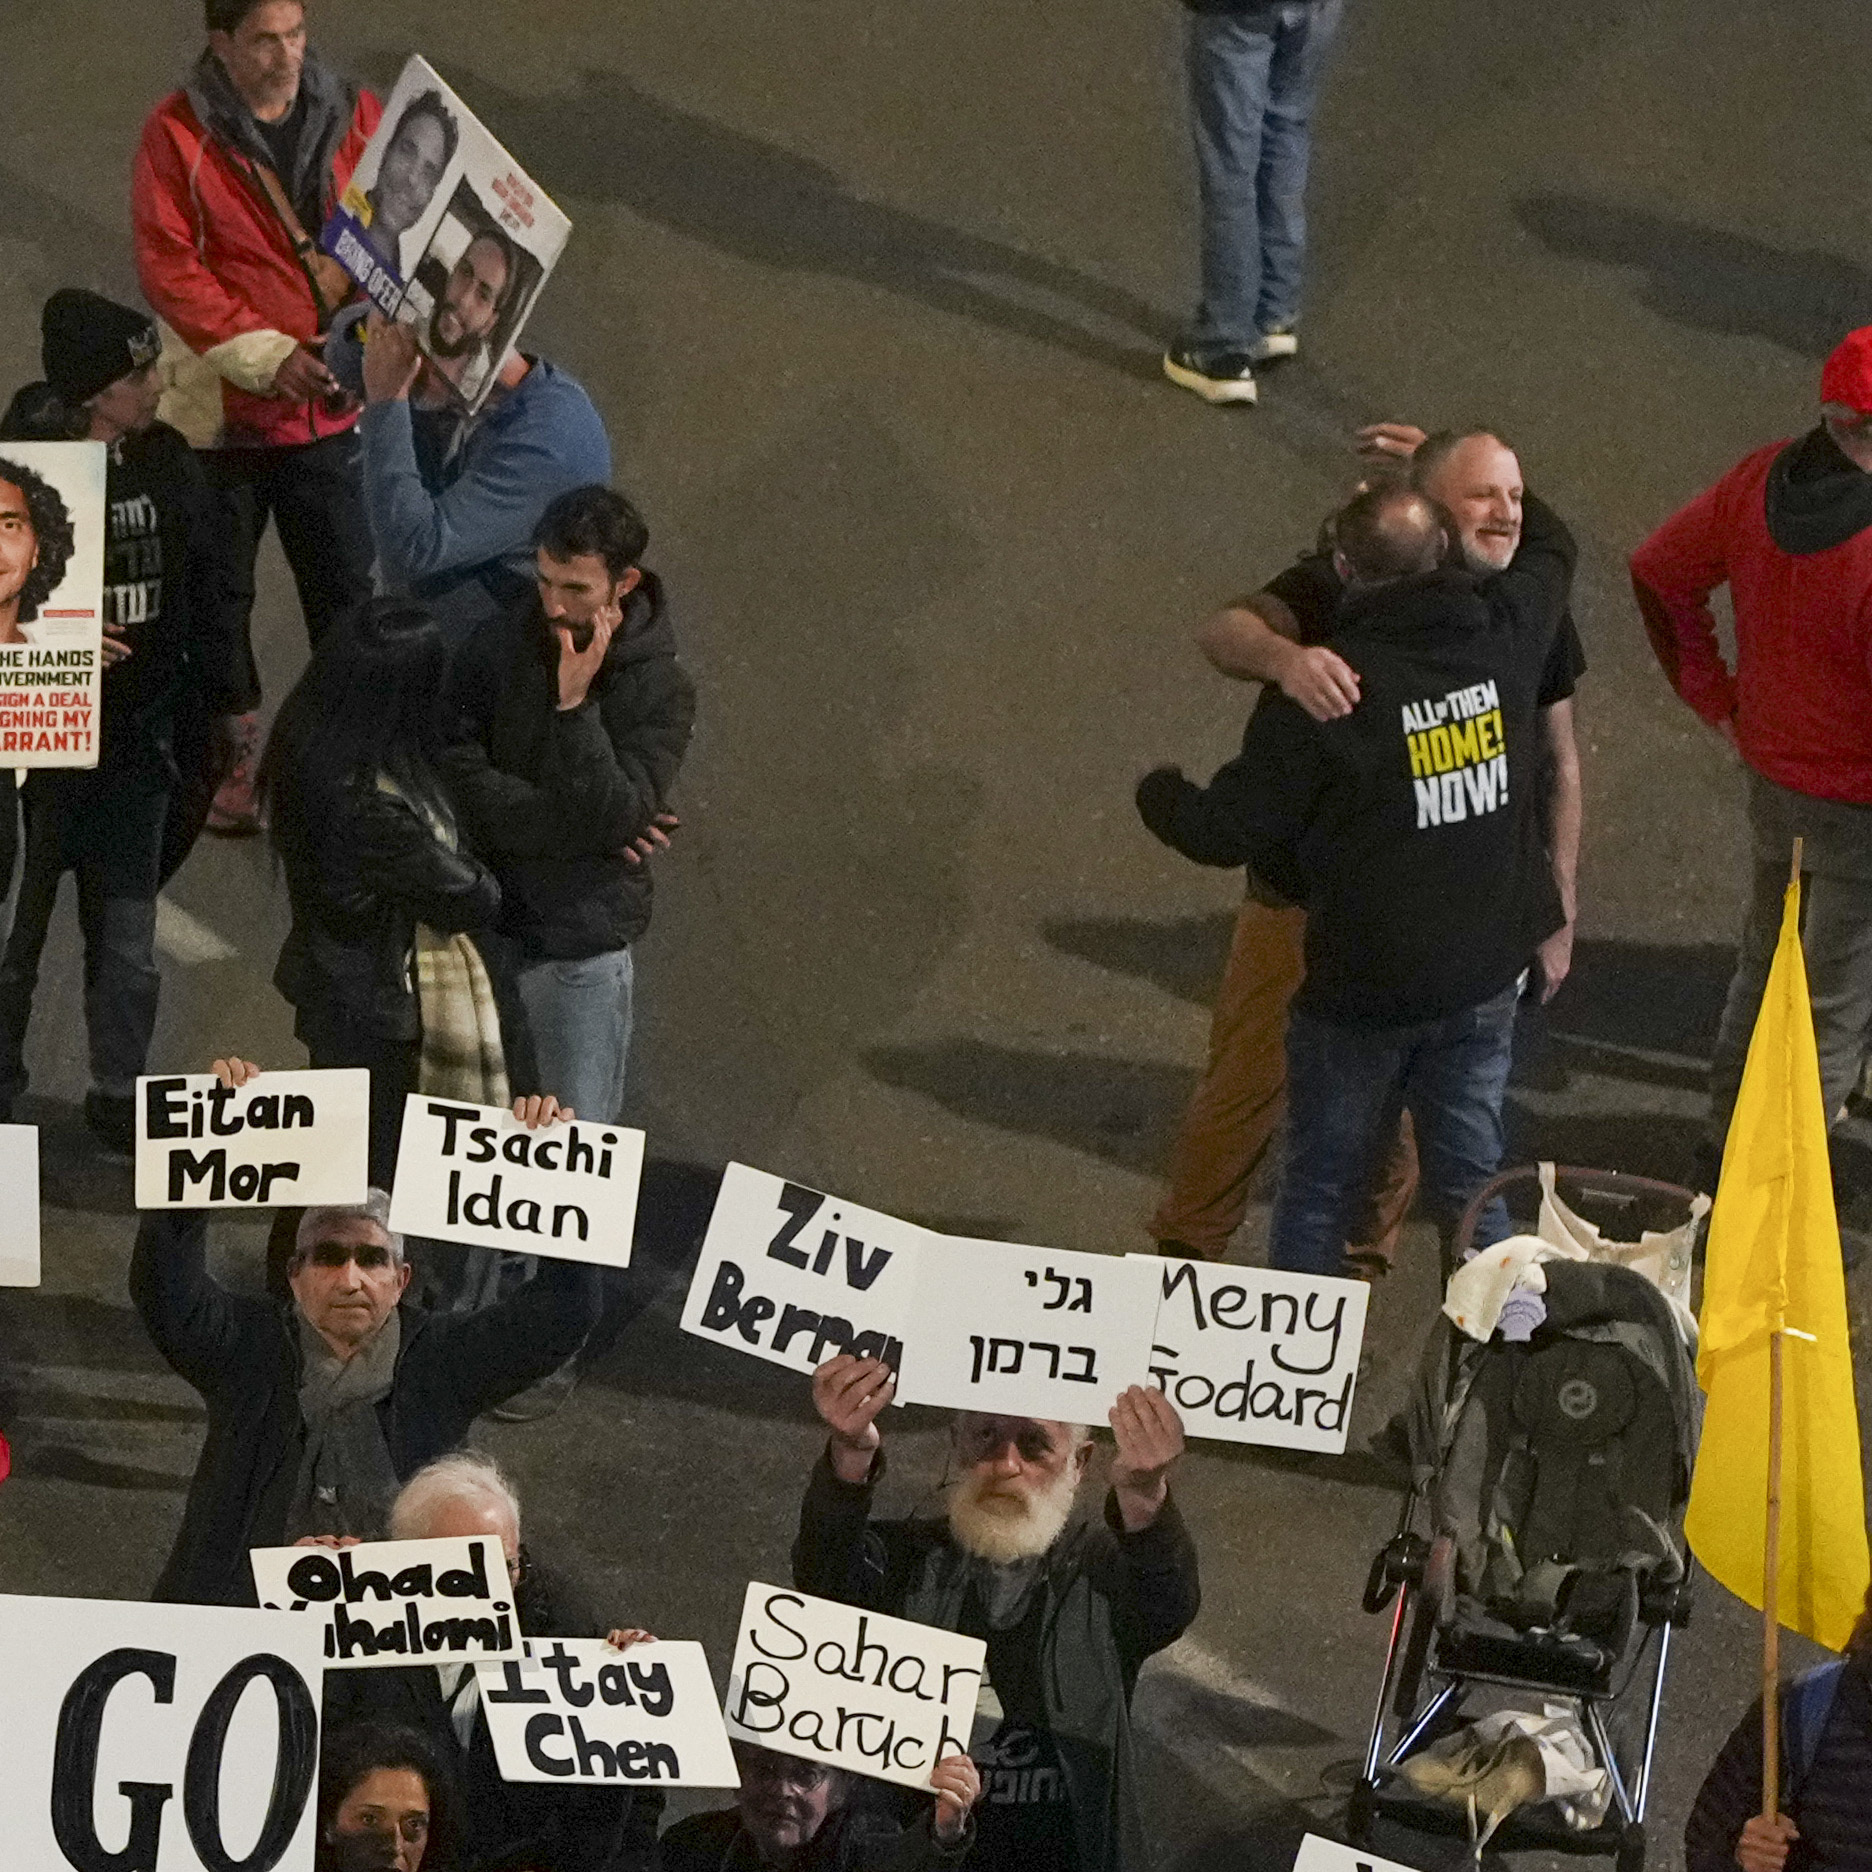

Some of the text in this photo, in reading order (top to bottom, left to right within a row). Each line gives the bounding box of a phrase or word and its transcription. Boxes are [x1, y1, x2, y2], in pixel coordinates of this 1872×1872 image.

[28, 651, 94, 667] HANDS
[32, 693, 45, 707] A
[48, 692, 92, 707] DEAL
[62, 711, 91, 728] MY
[1403, 680, 1499, 732] ALL THEM
[1408, 711, 1506, 776] HOME!
[1413, 757, 1510, 829] NOW!
[146, 1077, 316, 1140] Eitan
[427, 1103, 620, 1181] Tsachi
[167, 1147, 300, 1204] Mor
[765, 1180, 895, 1294] Ziv
[1024, 1268, 1094, 1315] גלי
[969, 1334, 1099, 1386] ברמן
[286, 1541, 490, 1602] Ohad
[749, 1594, 983, 1706] Sahar
[524, 1713, 680, 1781] Chen
